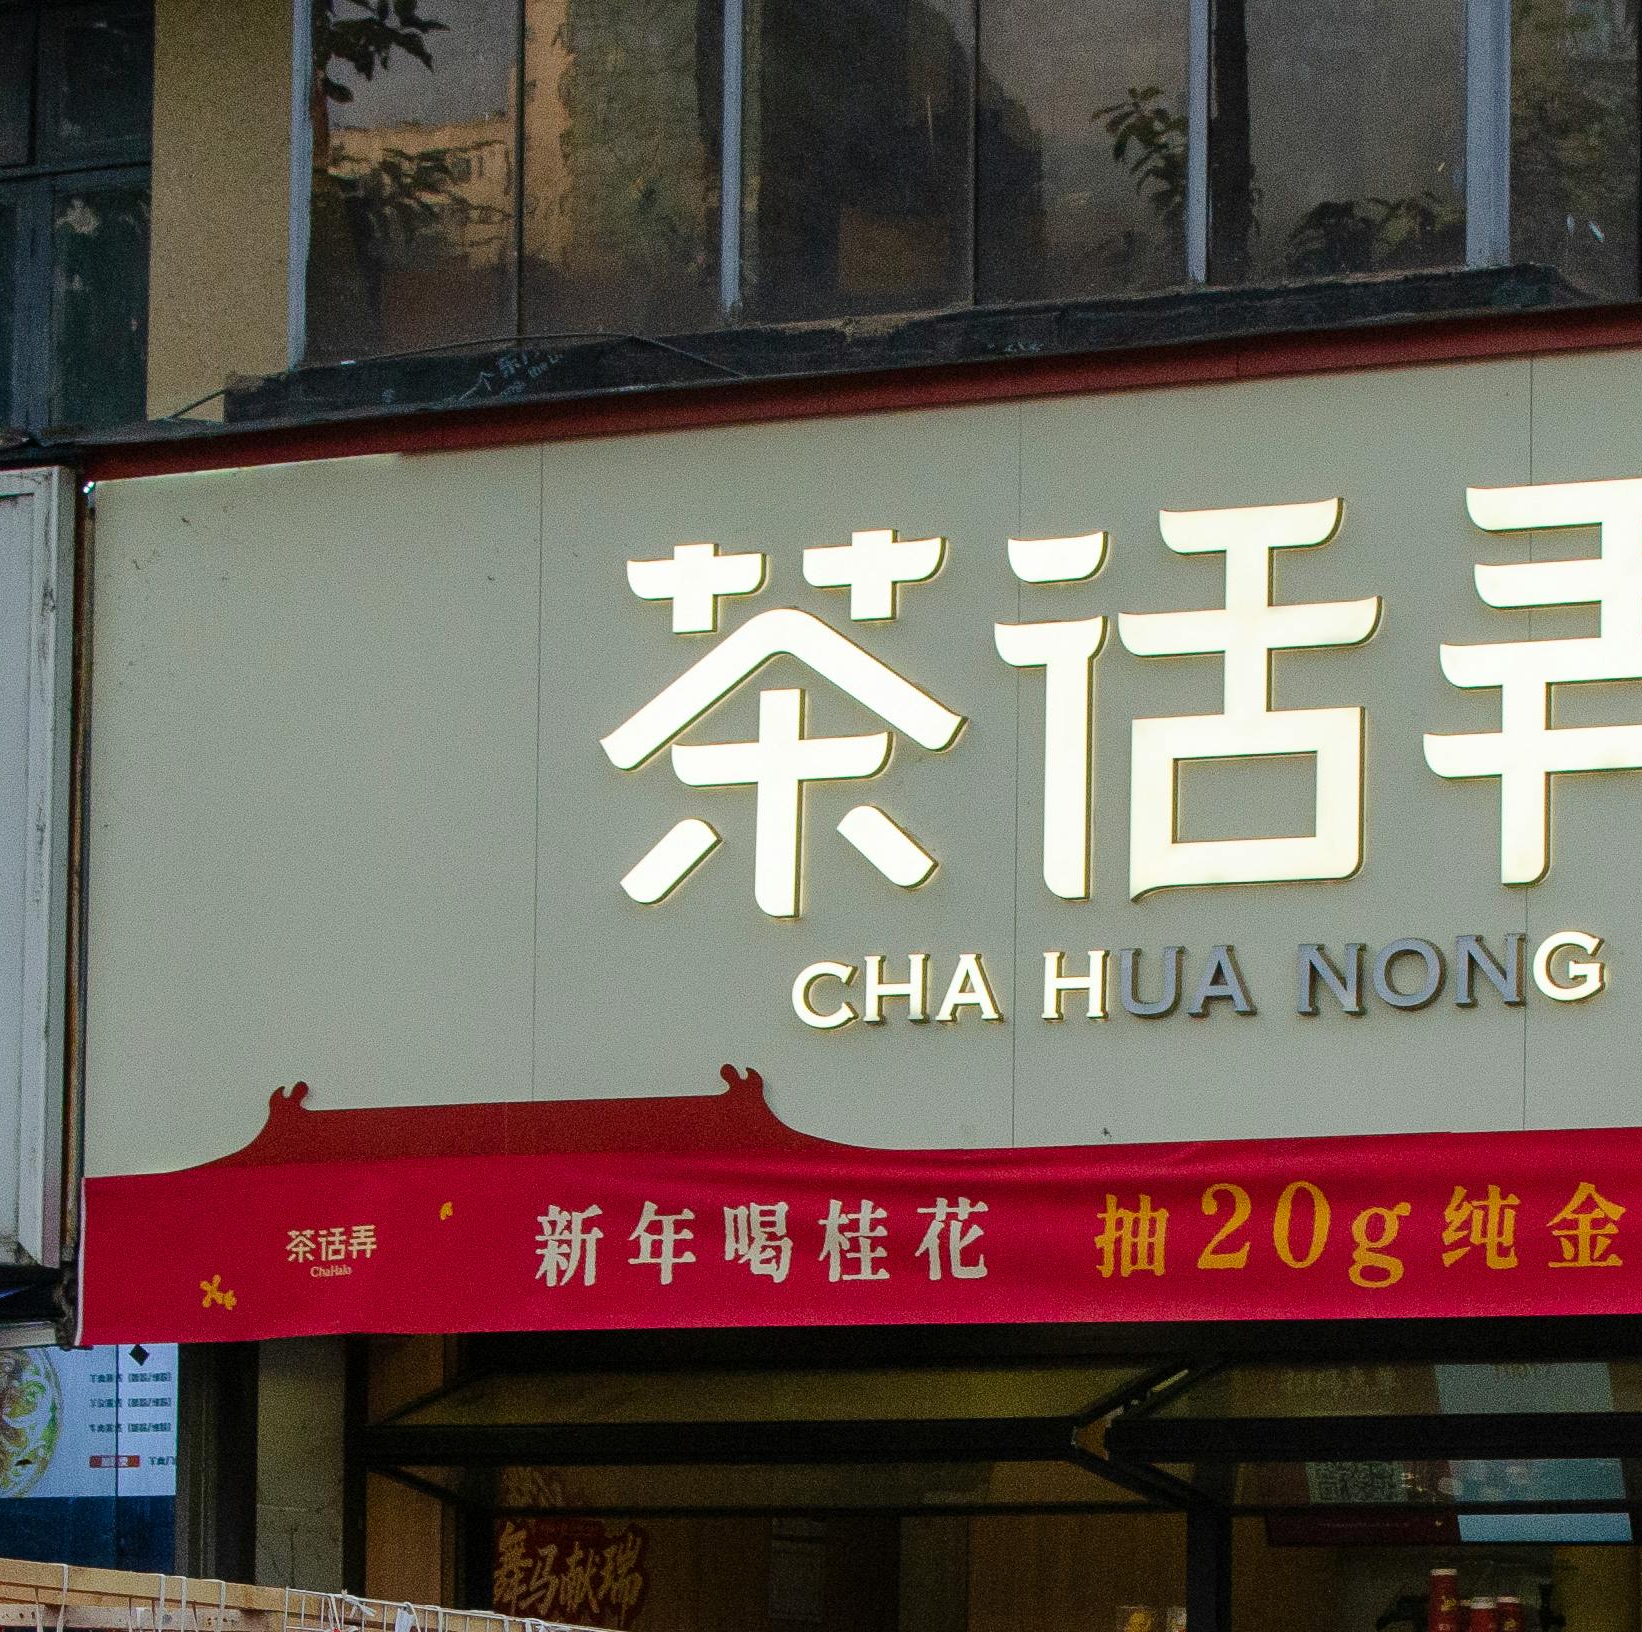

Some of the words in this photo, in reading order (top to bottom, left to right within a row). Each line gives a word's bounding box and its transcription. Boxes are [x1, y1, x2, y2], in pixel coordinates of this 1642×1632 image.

[791, 952, 1004, 1029] CHA
[1041, 942, 1256, 1021] HUA
[1297, 931, 1608, 1017] NONG
[285, 1223, 378, 1264] 茶话弄
[534, 1197, 990, 1287] 新年喝桂花
